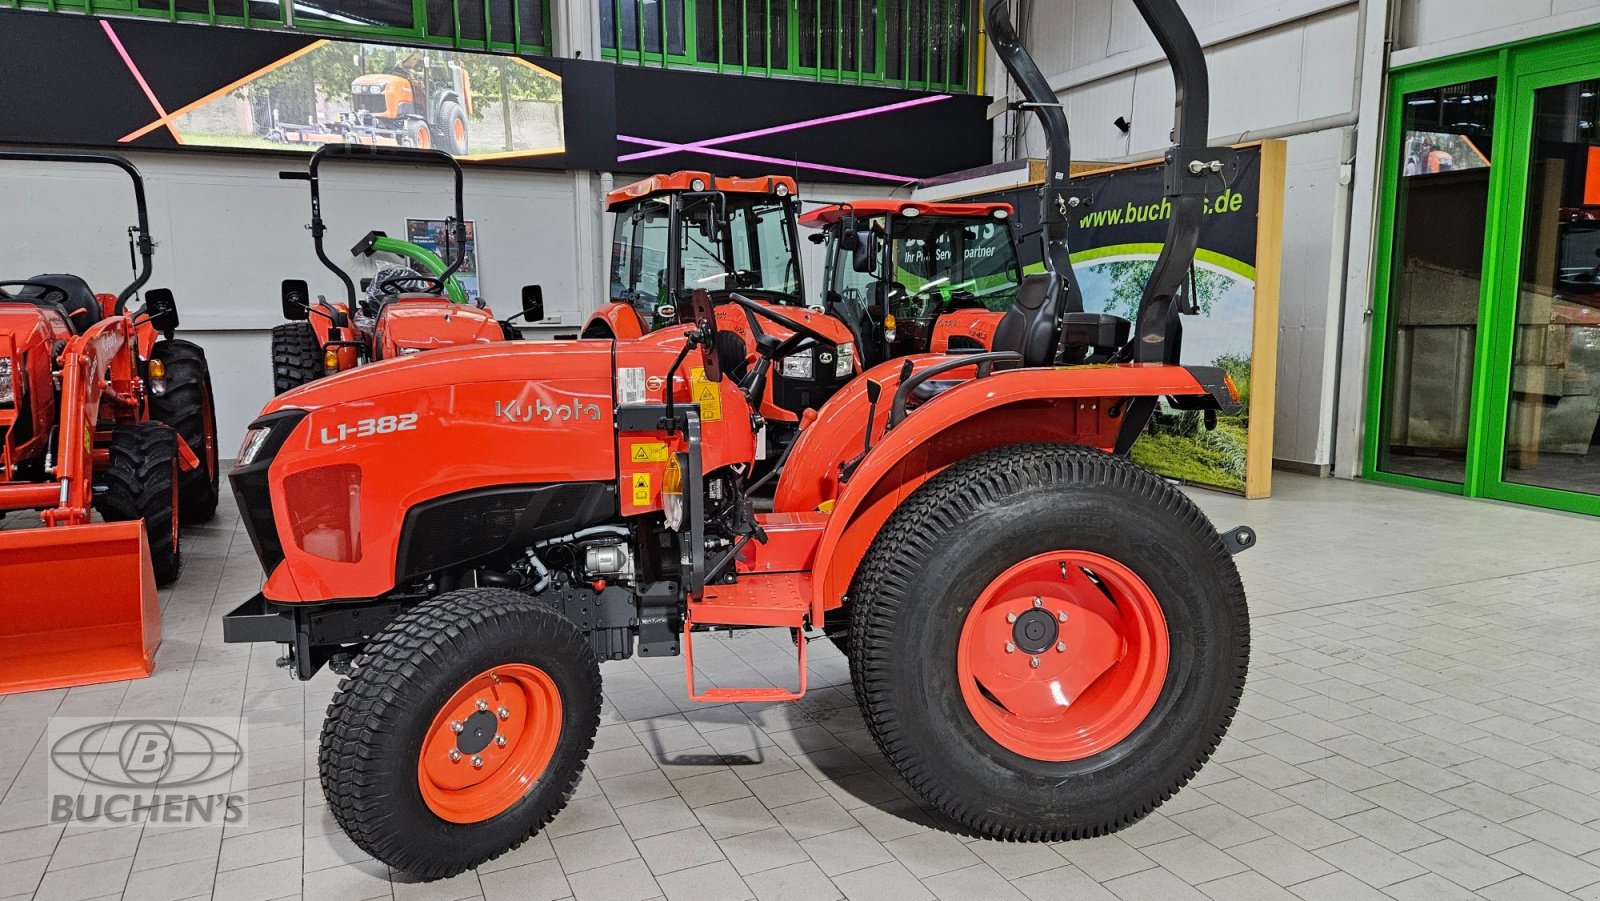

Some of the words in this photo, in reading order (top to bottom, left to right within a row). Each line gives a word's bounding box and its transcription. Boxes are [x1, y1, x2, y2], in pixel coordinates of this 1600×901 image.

[1079, 188, 1243, 229] www.buch.de
[495, 398, 600, 422] Kubota
[320, 413, 418, 445] L1-382
